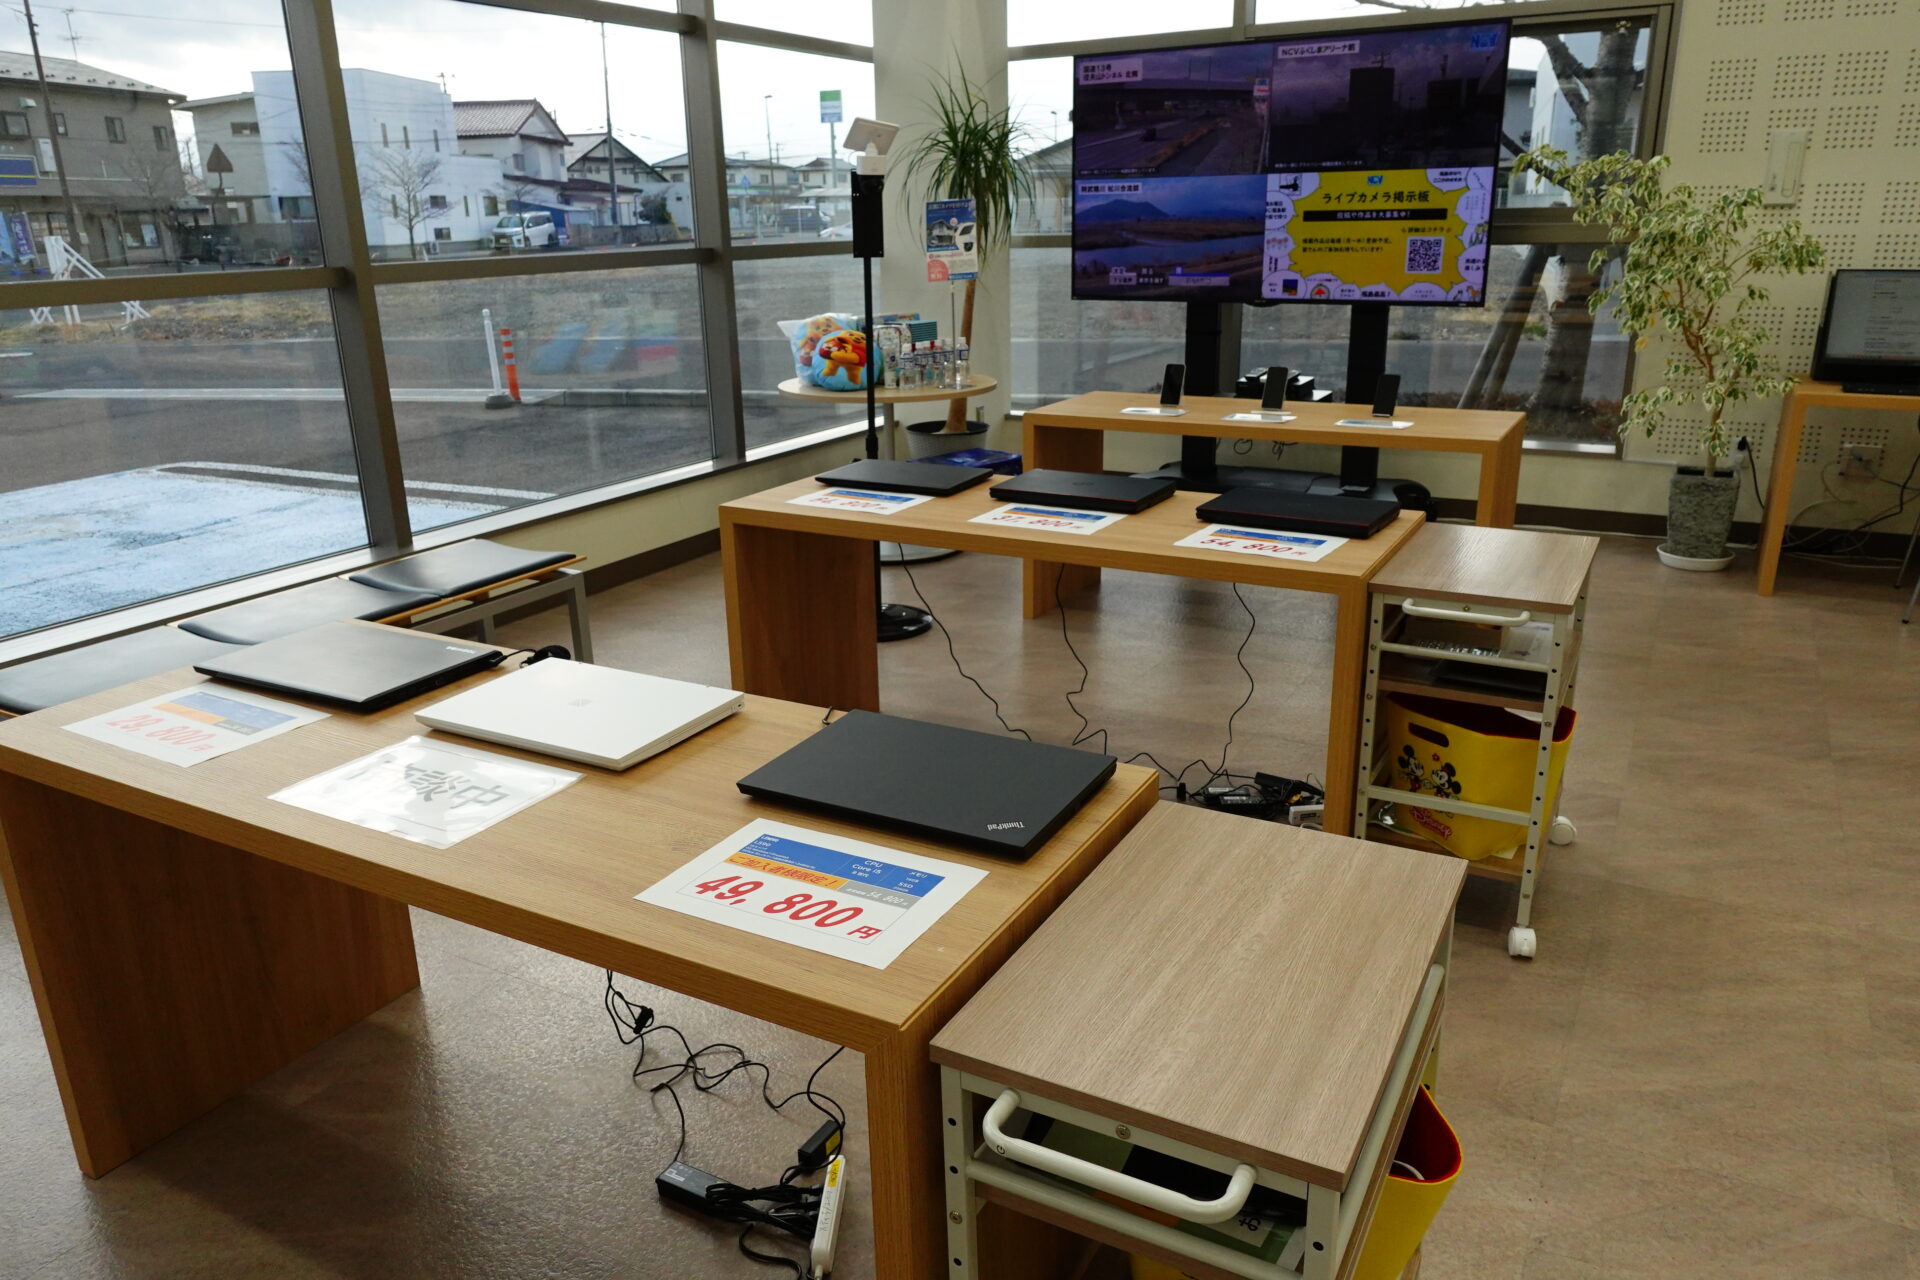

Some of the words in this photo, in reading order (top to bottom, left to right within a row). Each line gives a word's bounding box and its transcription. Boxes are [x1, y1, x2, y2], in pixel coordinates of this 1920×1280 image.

[1323, 190, 1430, 204] ライブカメラ掲示板
[987, 821, 1024, 831] ThinkPad
[852, 864, 871, 872] Core
[864, 860, 883, 868] CPU
[909, 871, 928, 879] メモリ
